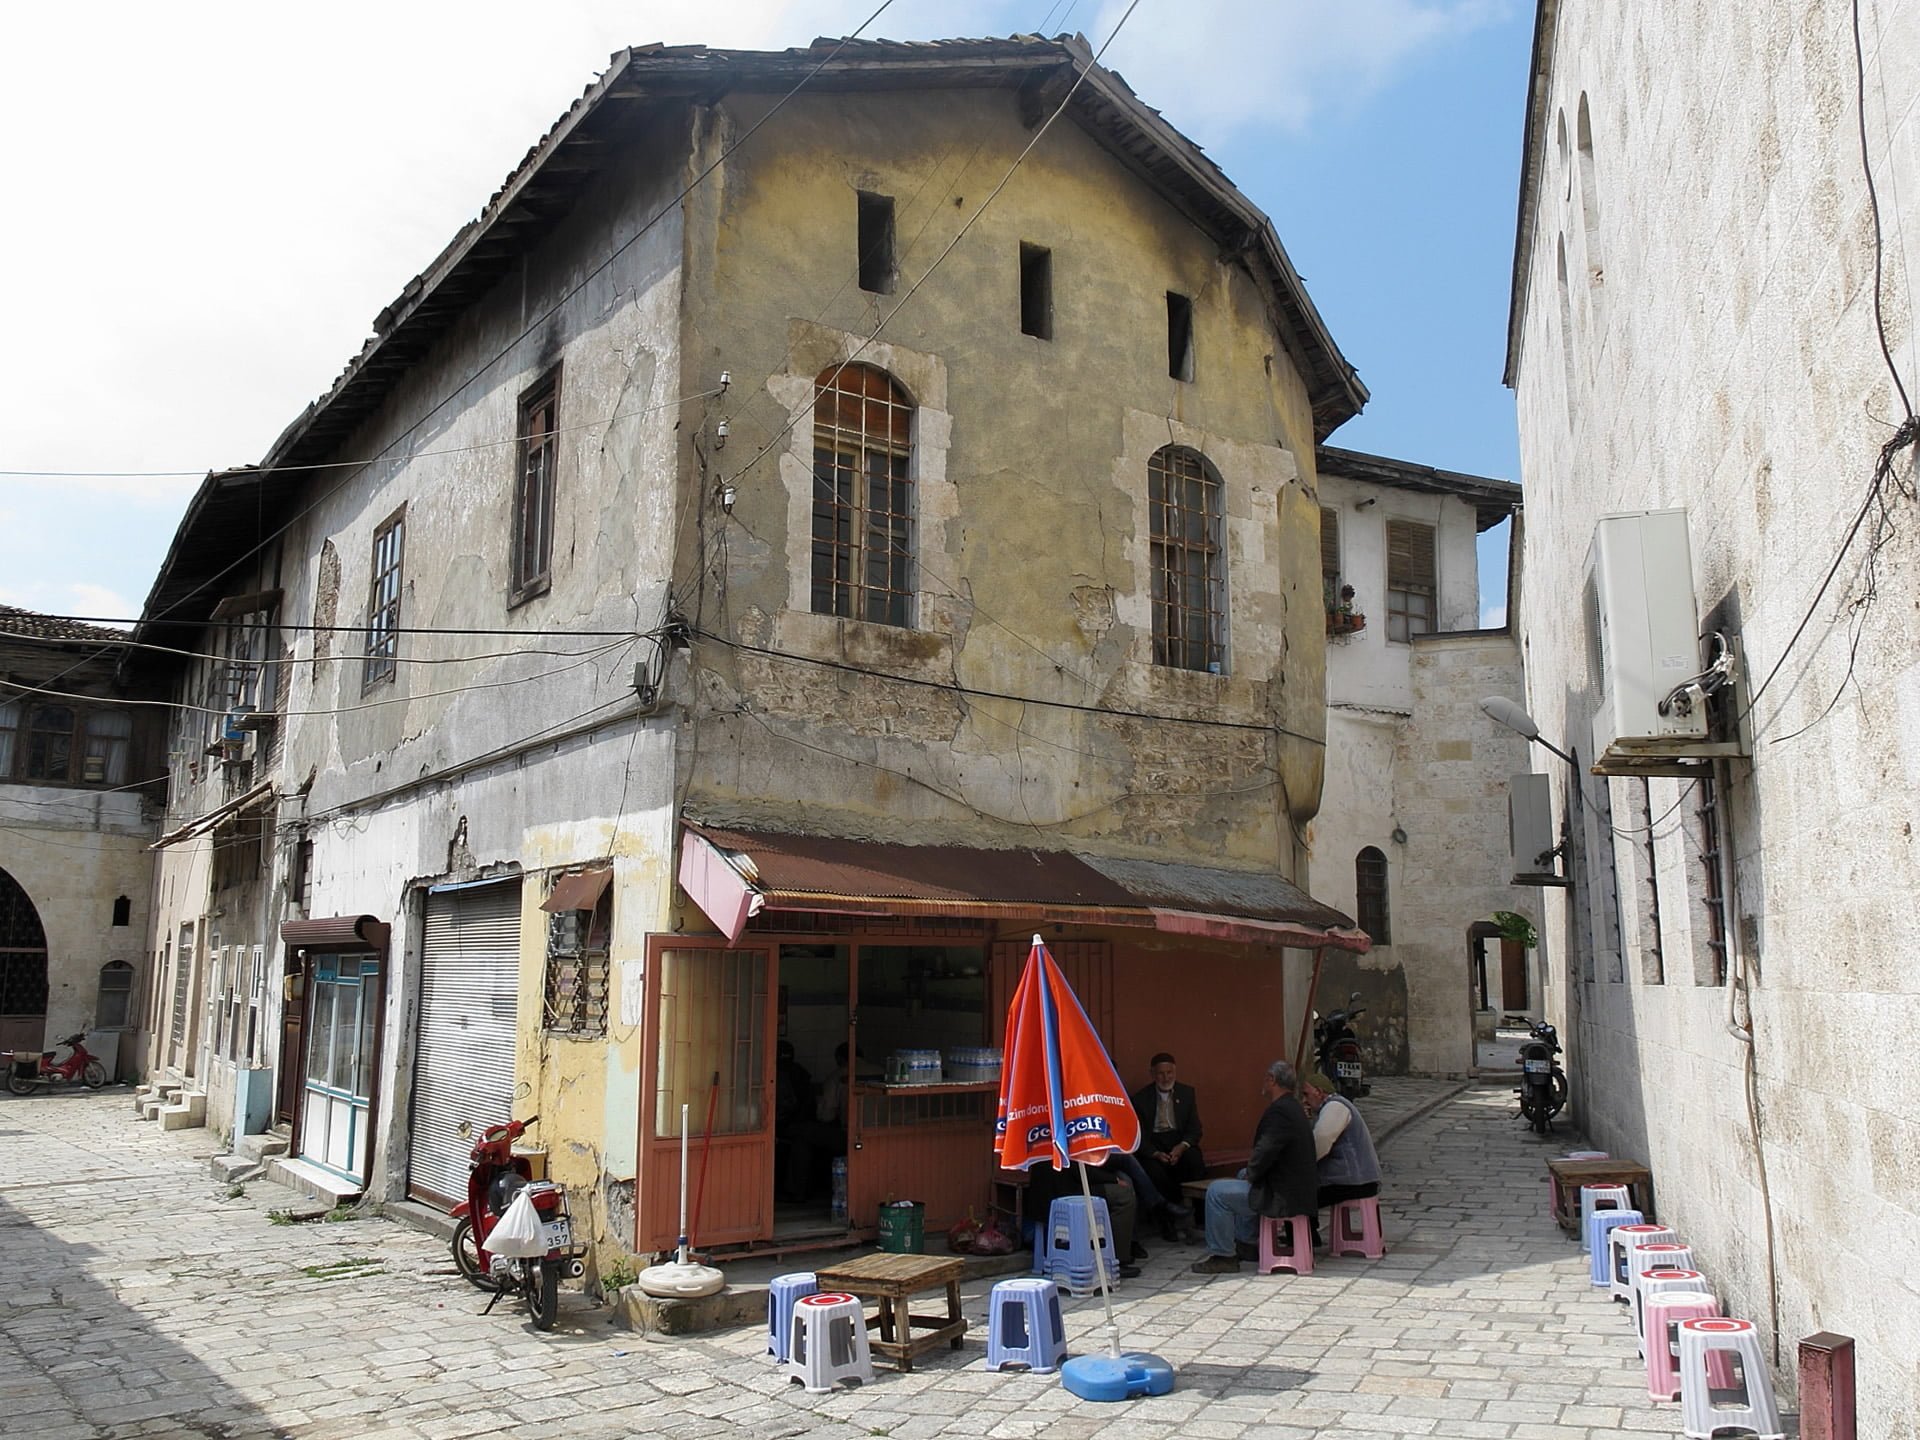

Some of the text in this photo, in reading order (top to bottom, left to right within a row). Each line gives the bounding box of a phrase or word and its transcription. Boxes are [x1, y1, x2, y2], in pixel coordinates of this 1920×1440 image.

[1063, 1093, 1125, 1109] ondurmamız
[1065, 1116, 1103, 1137] Golf
[547, 1234, 568, 1247] 357
